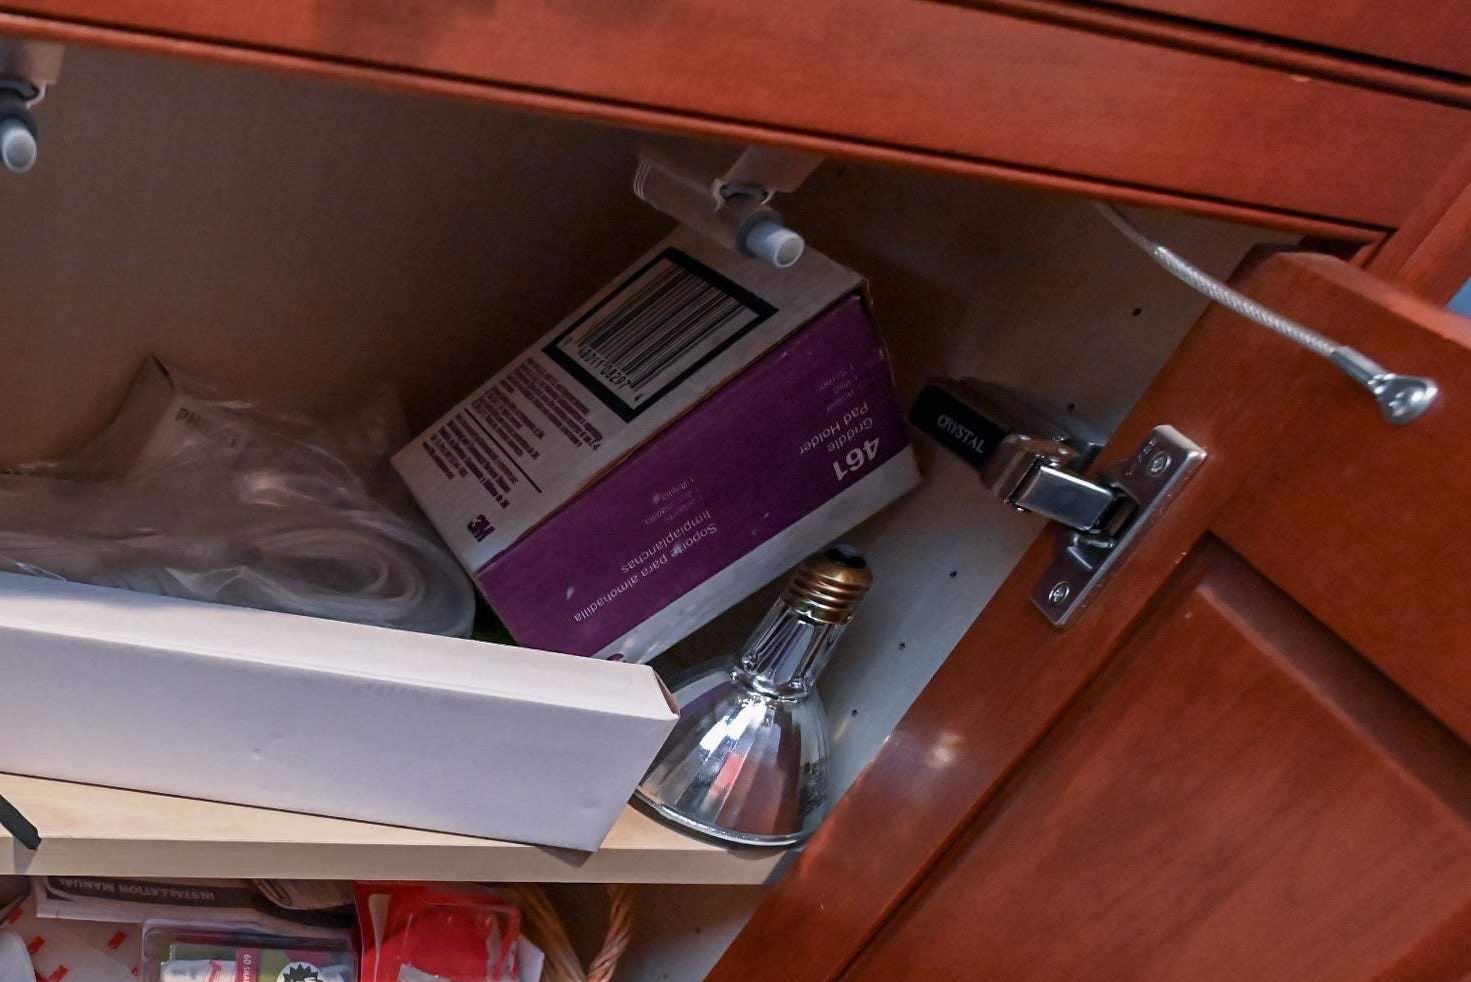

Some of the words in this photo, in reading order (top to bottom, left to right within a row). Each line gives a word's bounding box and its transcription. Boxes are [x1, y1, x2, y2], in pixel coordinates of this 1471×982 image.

[843, 402, 869, 426] Pad
[799, 421, 841, 456] Holder
[827, 417, 873, 452] Griddle
[936, 414, 985, 454] CRYSTAL
[832, 438, 880, 481] 461
[467, 514, 496, 543] 3M
[671, 522, 717, 557] Soporte
[641, 553, 668, 577] para
[574, 574, 638, 622] almohadilla
[59, 878, 114, 892] MANUAL
[119, 883, 215, 901] INSTALLATION
[243, 954, 252, 964] 60
